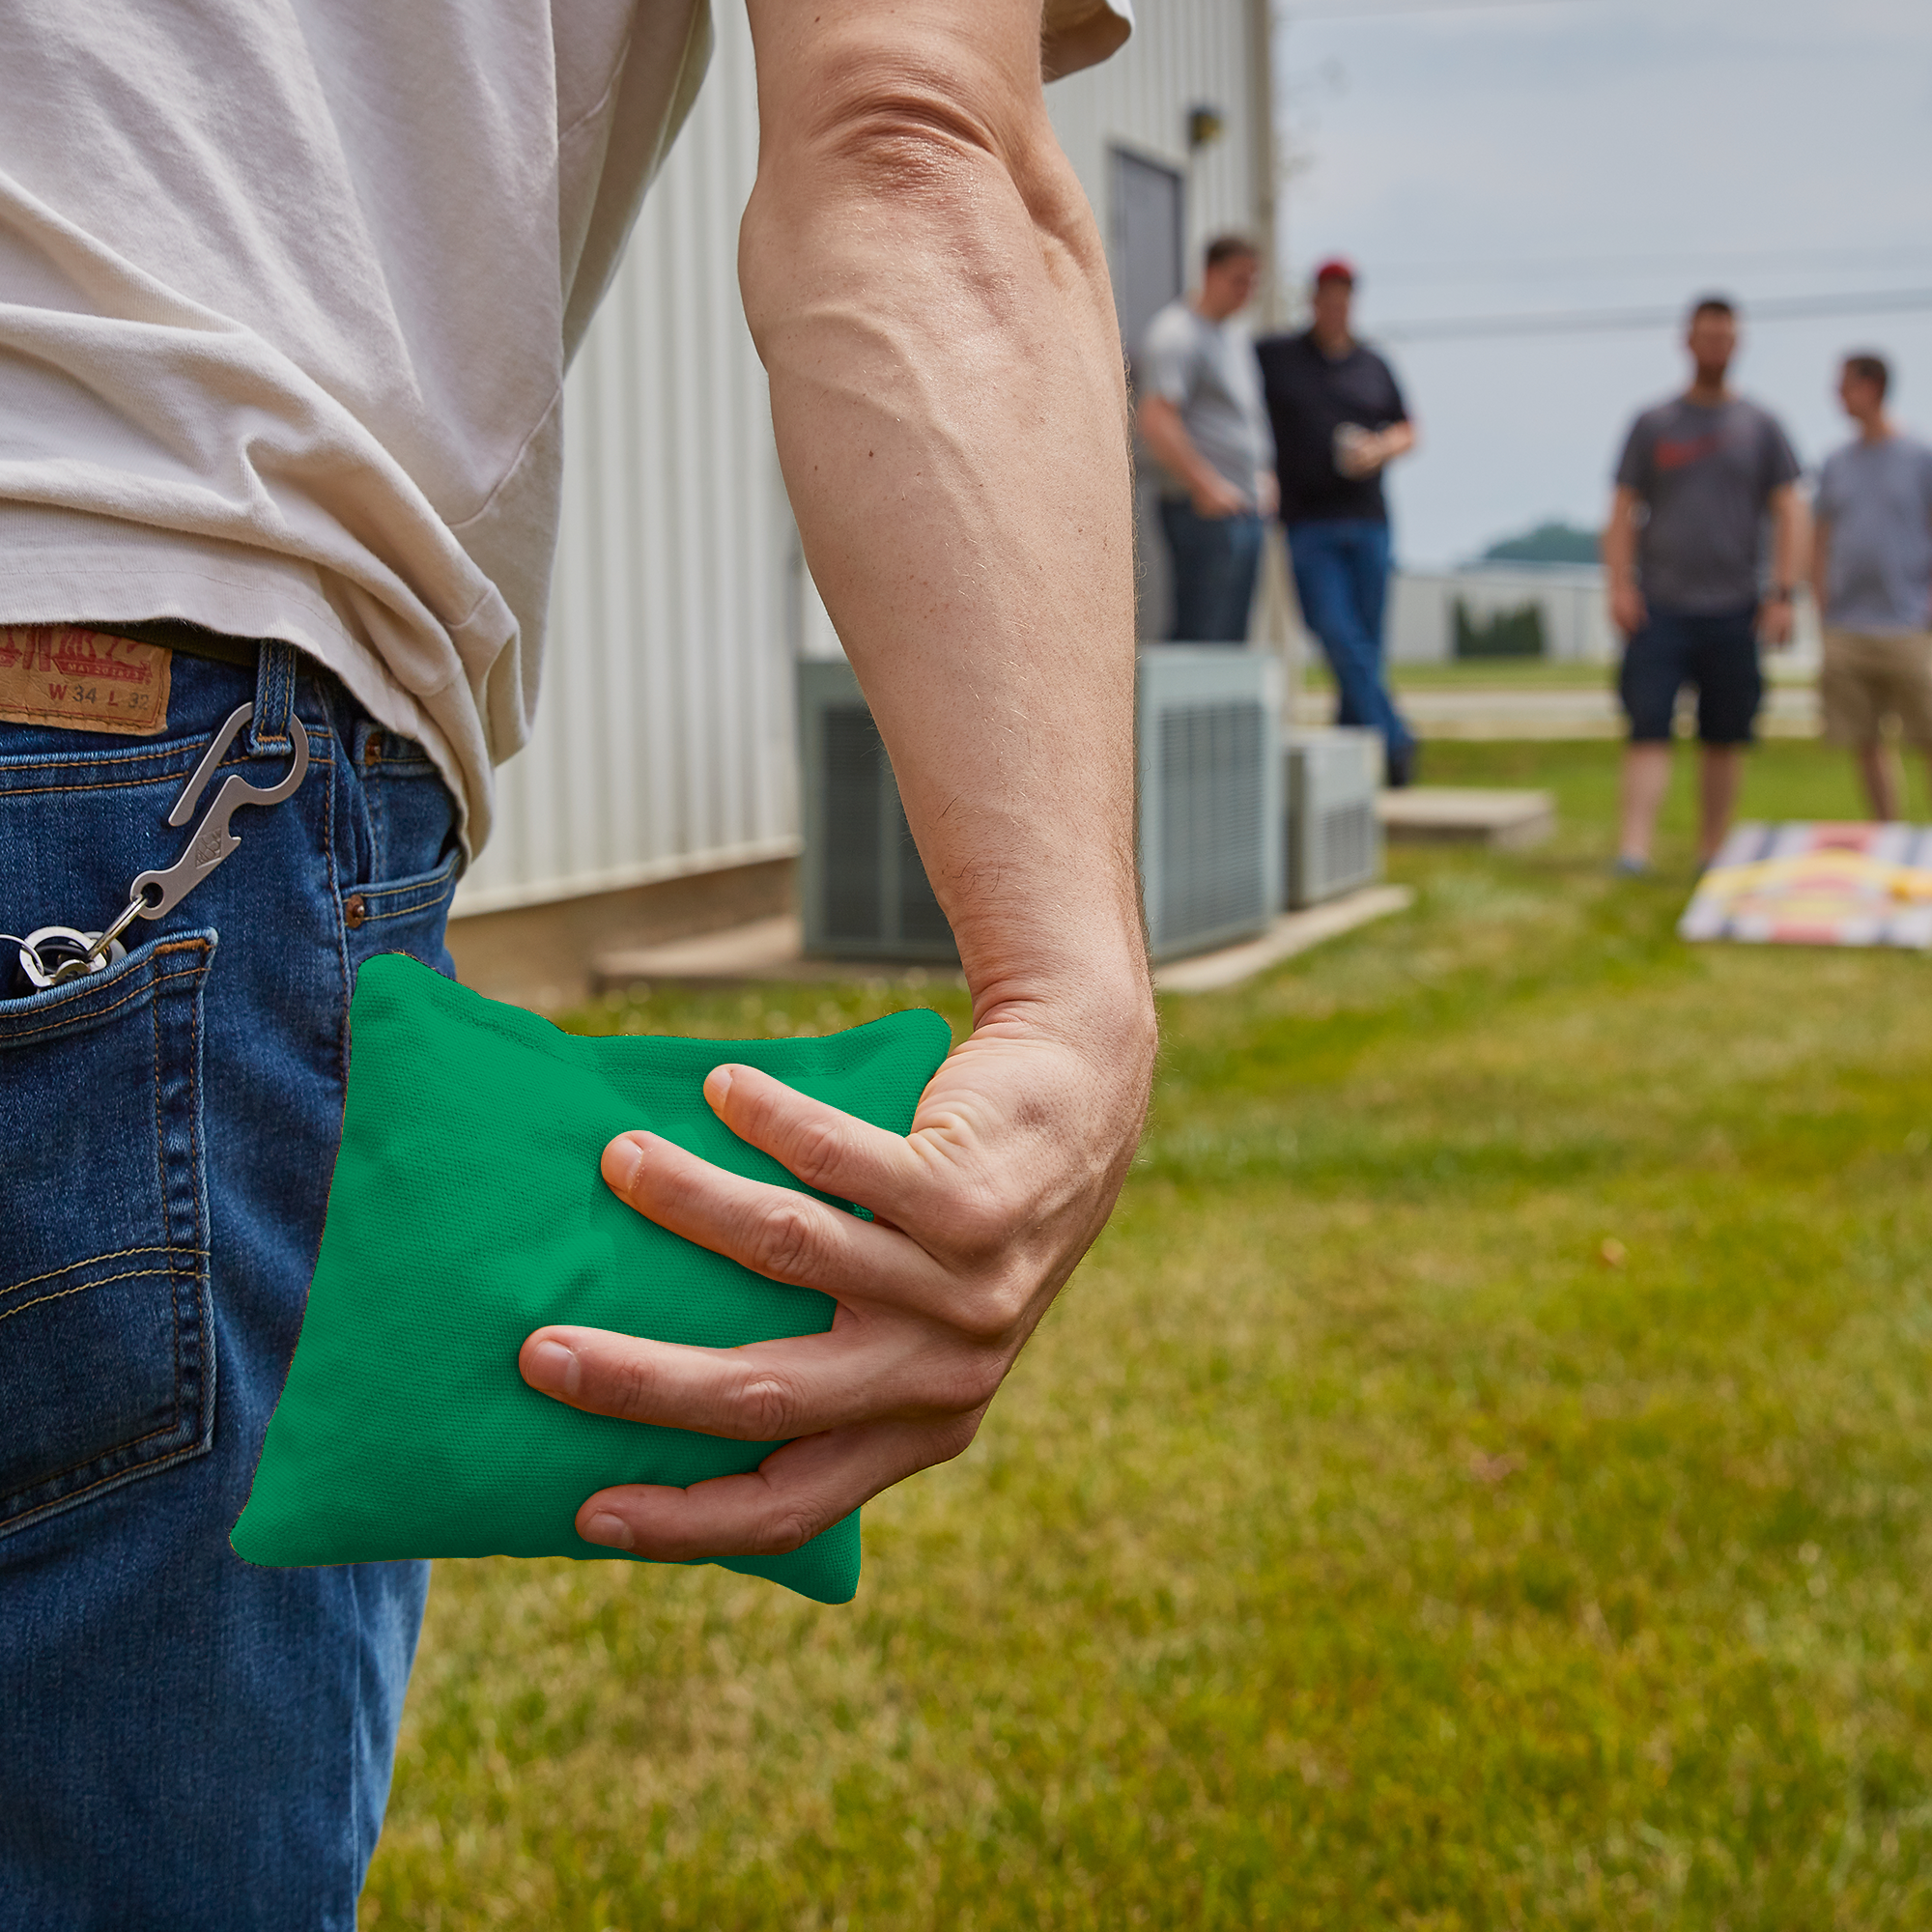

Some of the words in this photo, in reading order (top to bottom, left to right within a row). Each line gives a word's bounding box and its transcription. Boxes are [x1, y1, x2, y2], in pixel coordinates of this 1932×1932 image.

[48, 683, 68, 700] W
[72, 684, 97, 703] 34
[108, 691, 119, 706] L
[128, 693, 150, 710] 32
